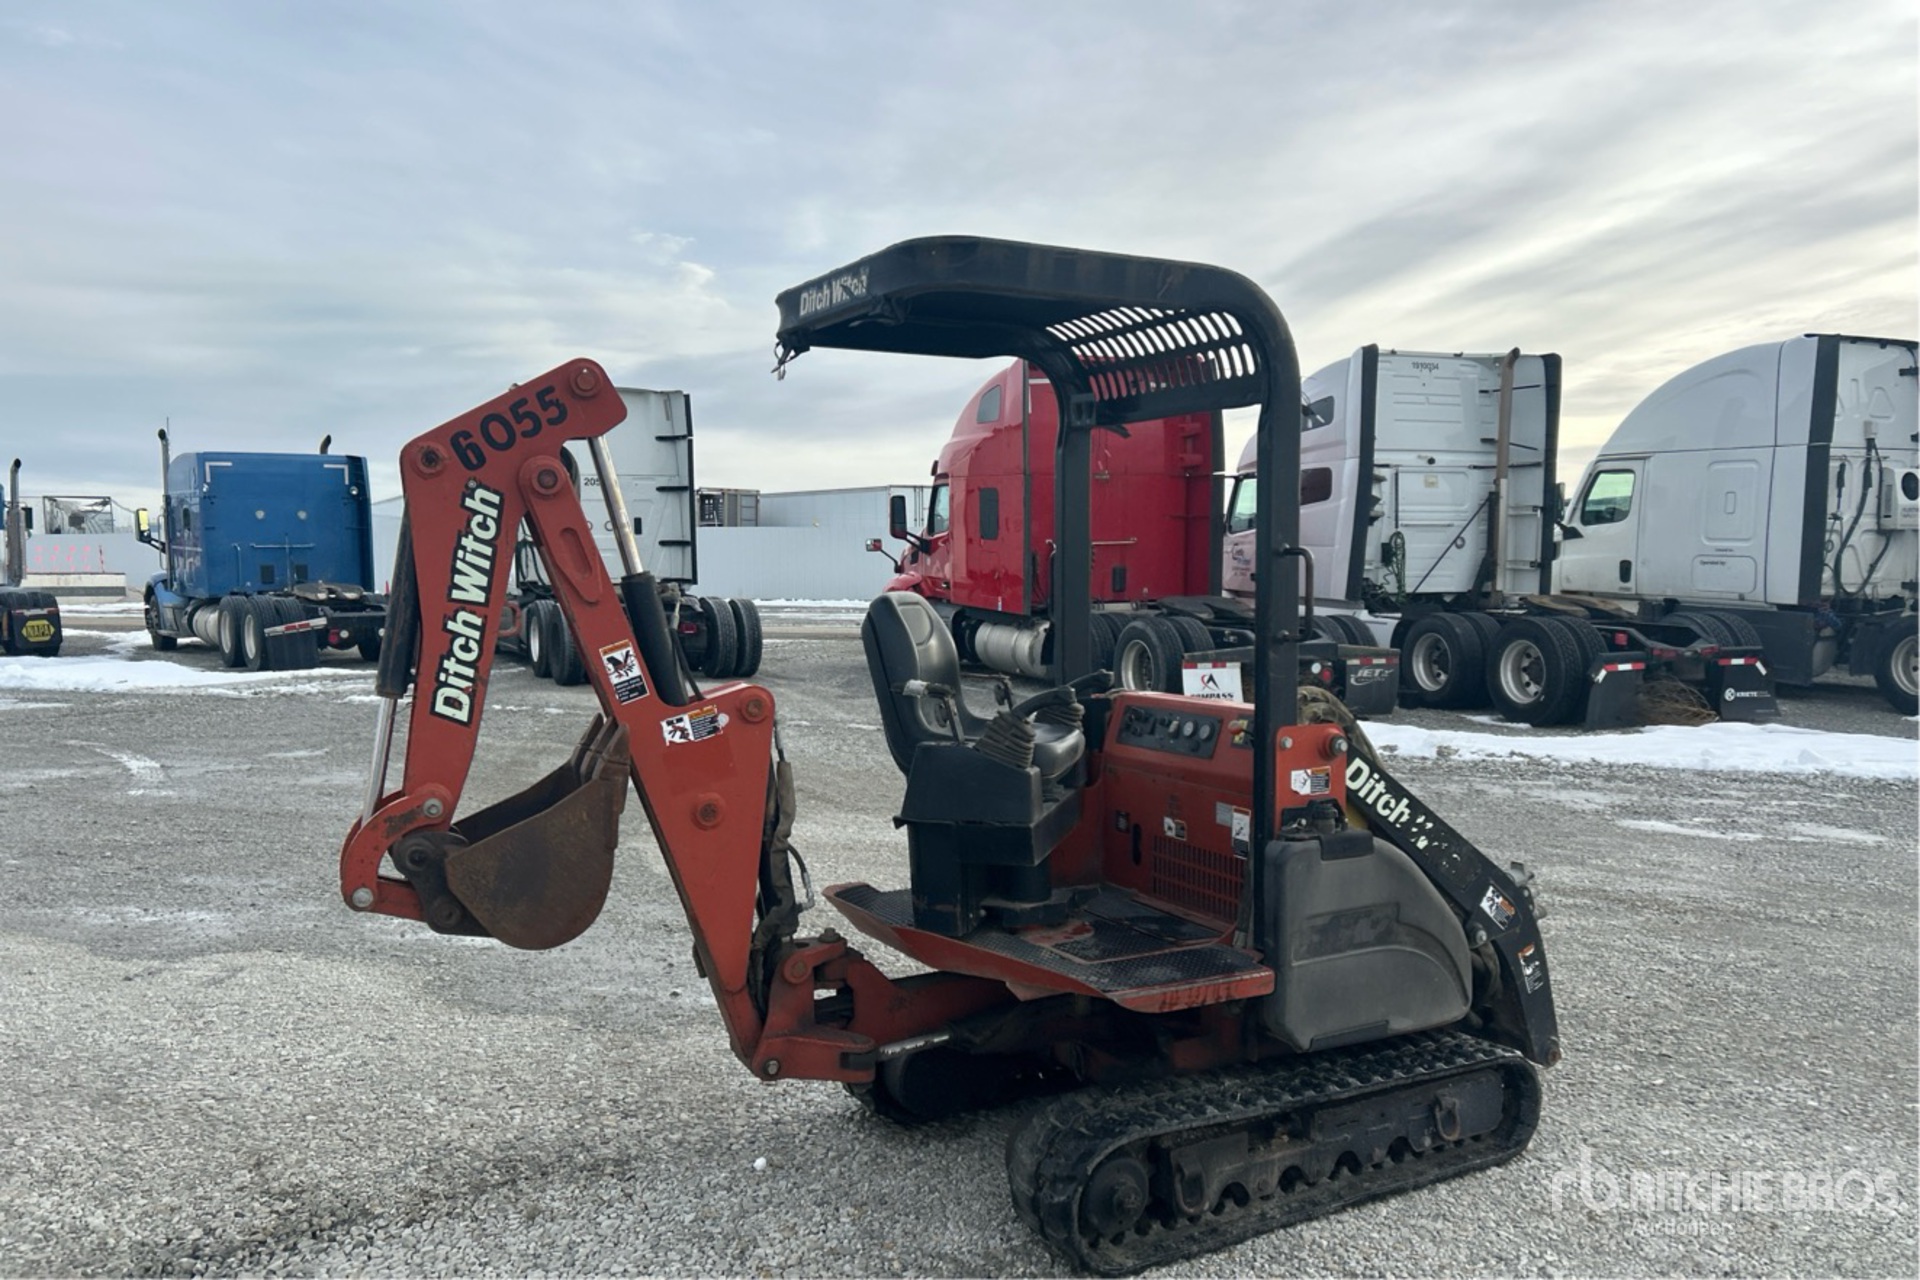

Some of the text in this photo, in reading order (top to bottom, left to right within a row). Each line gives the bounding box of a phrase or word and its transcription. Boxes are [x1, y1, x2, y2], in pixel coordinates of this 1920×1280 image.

[800, 282, 831, 316] Ditch
[450, 386, 568, 471] 6055
[26, 624, 51, 637] NAPA
[434, 486, 501, 722] Ditch Witch
[1345, 757, 1411, 828] Ditch
